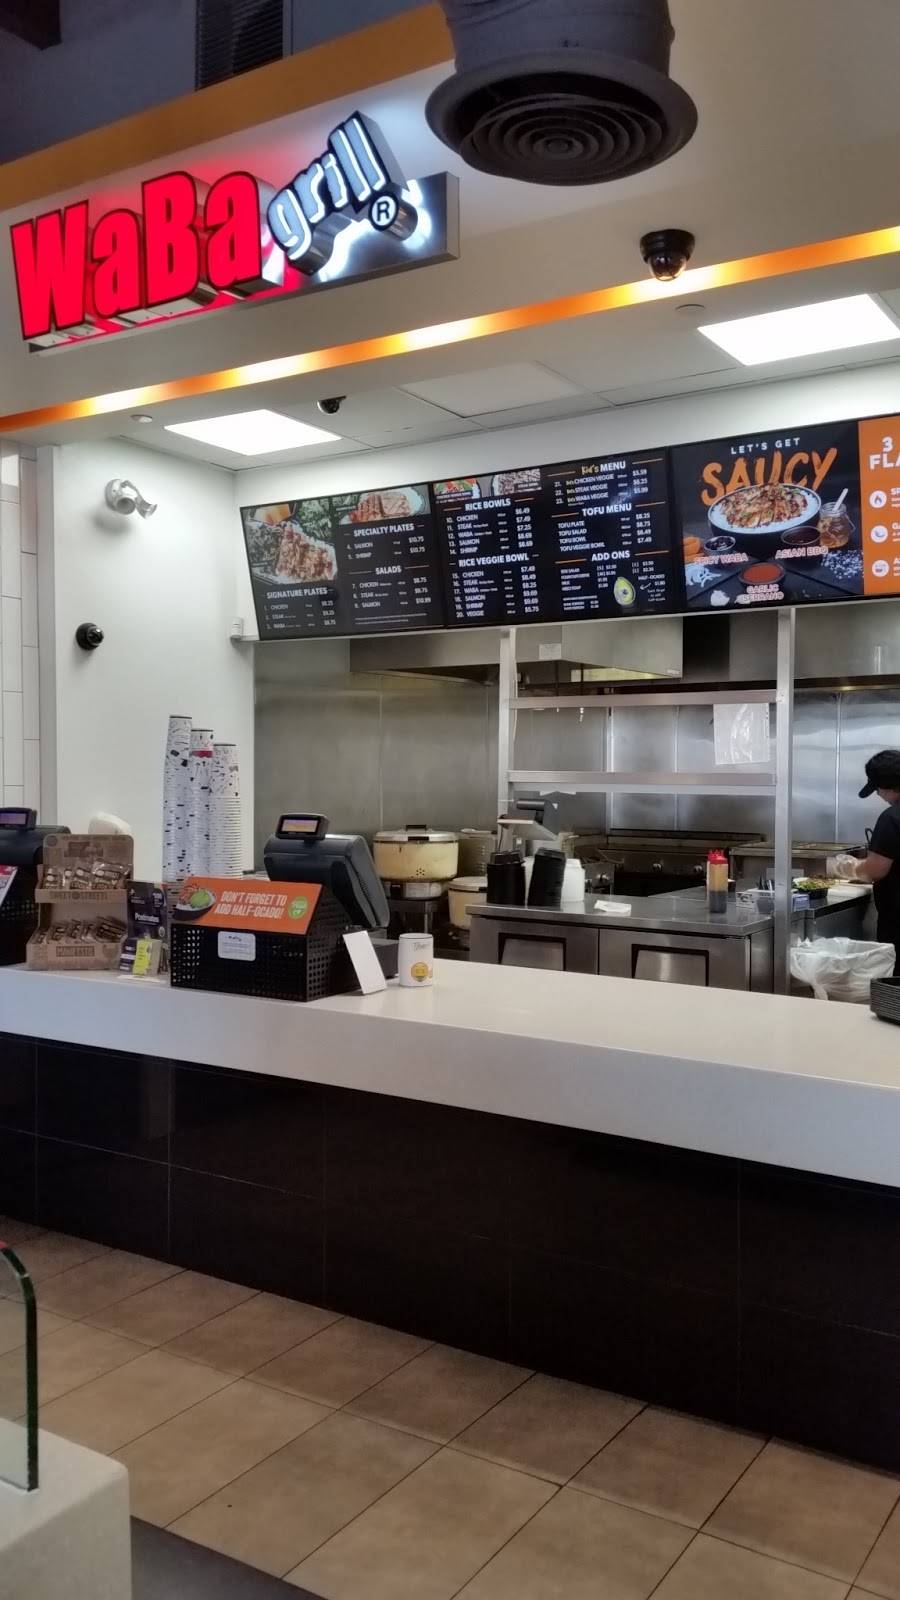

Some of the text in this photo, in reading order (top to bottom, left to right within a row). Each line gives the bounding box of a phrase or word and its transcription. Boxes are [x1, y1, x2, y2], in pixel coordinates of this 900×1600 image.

[266, 110, 394, 268] grill
[9, 170, 262, 340] WaBa
[731, 437, 800, 455] LET'S GET
[882, 436, 893, 453] 3
[600, 460, 626, 473] MENU
[701, 447, 838, 506] SAUCY
[465, 503, 482, 511] RICE
[483, 498, 511, 509] BOWLS
[582, 503, 632, 517] TOFU MENU
[456, 514, 478, 523] CHICKEN
[354, 523, 415, 537] SPECIALTY PLATES
[459, 538, 480, 546] SALMON
[458, 552, 529, 567] RICE VEGGIE BOWL
[592, 550, 630, 562] ADD ONS
[720, 552, 748, 564] WABA
[775, 548, 806, 560] ASIAN
[375, 565, 402, 575] SALADS
[462, 570, 484, 578] CHICKEN
[266, 587, 328, 599] SIGNATURE PLATES
[221, 890, 288, 906] DON'T FORGET TO
[215, 903, 231, 915] ADD
